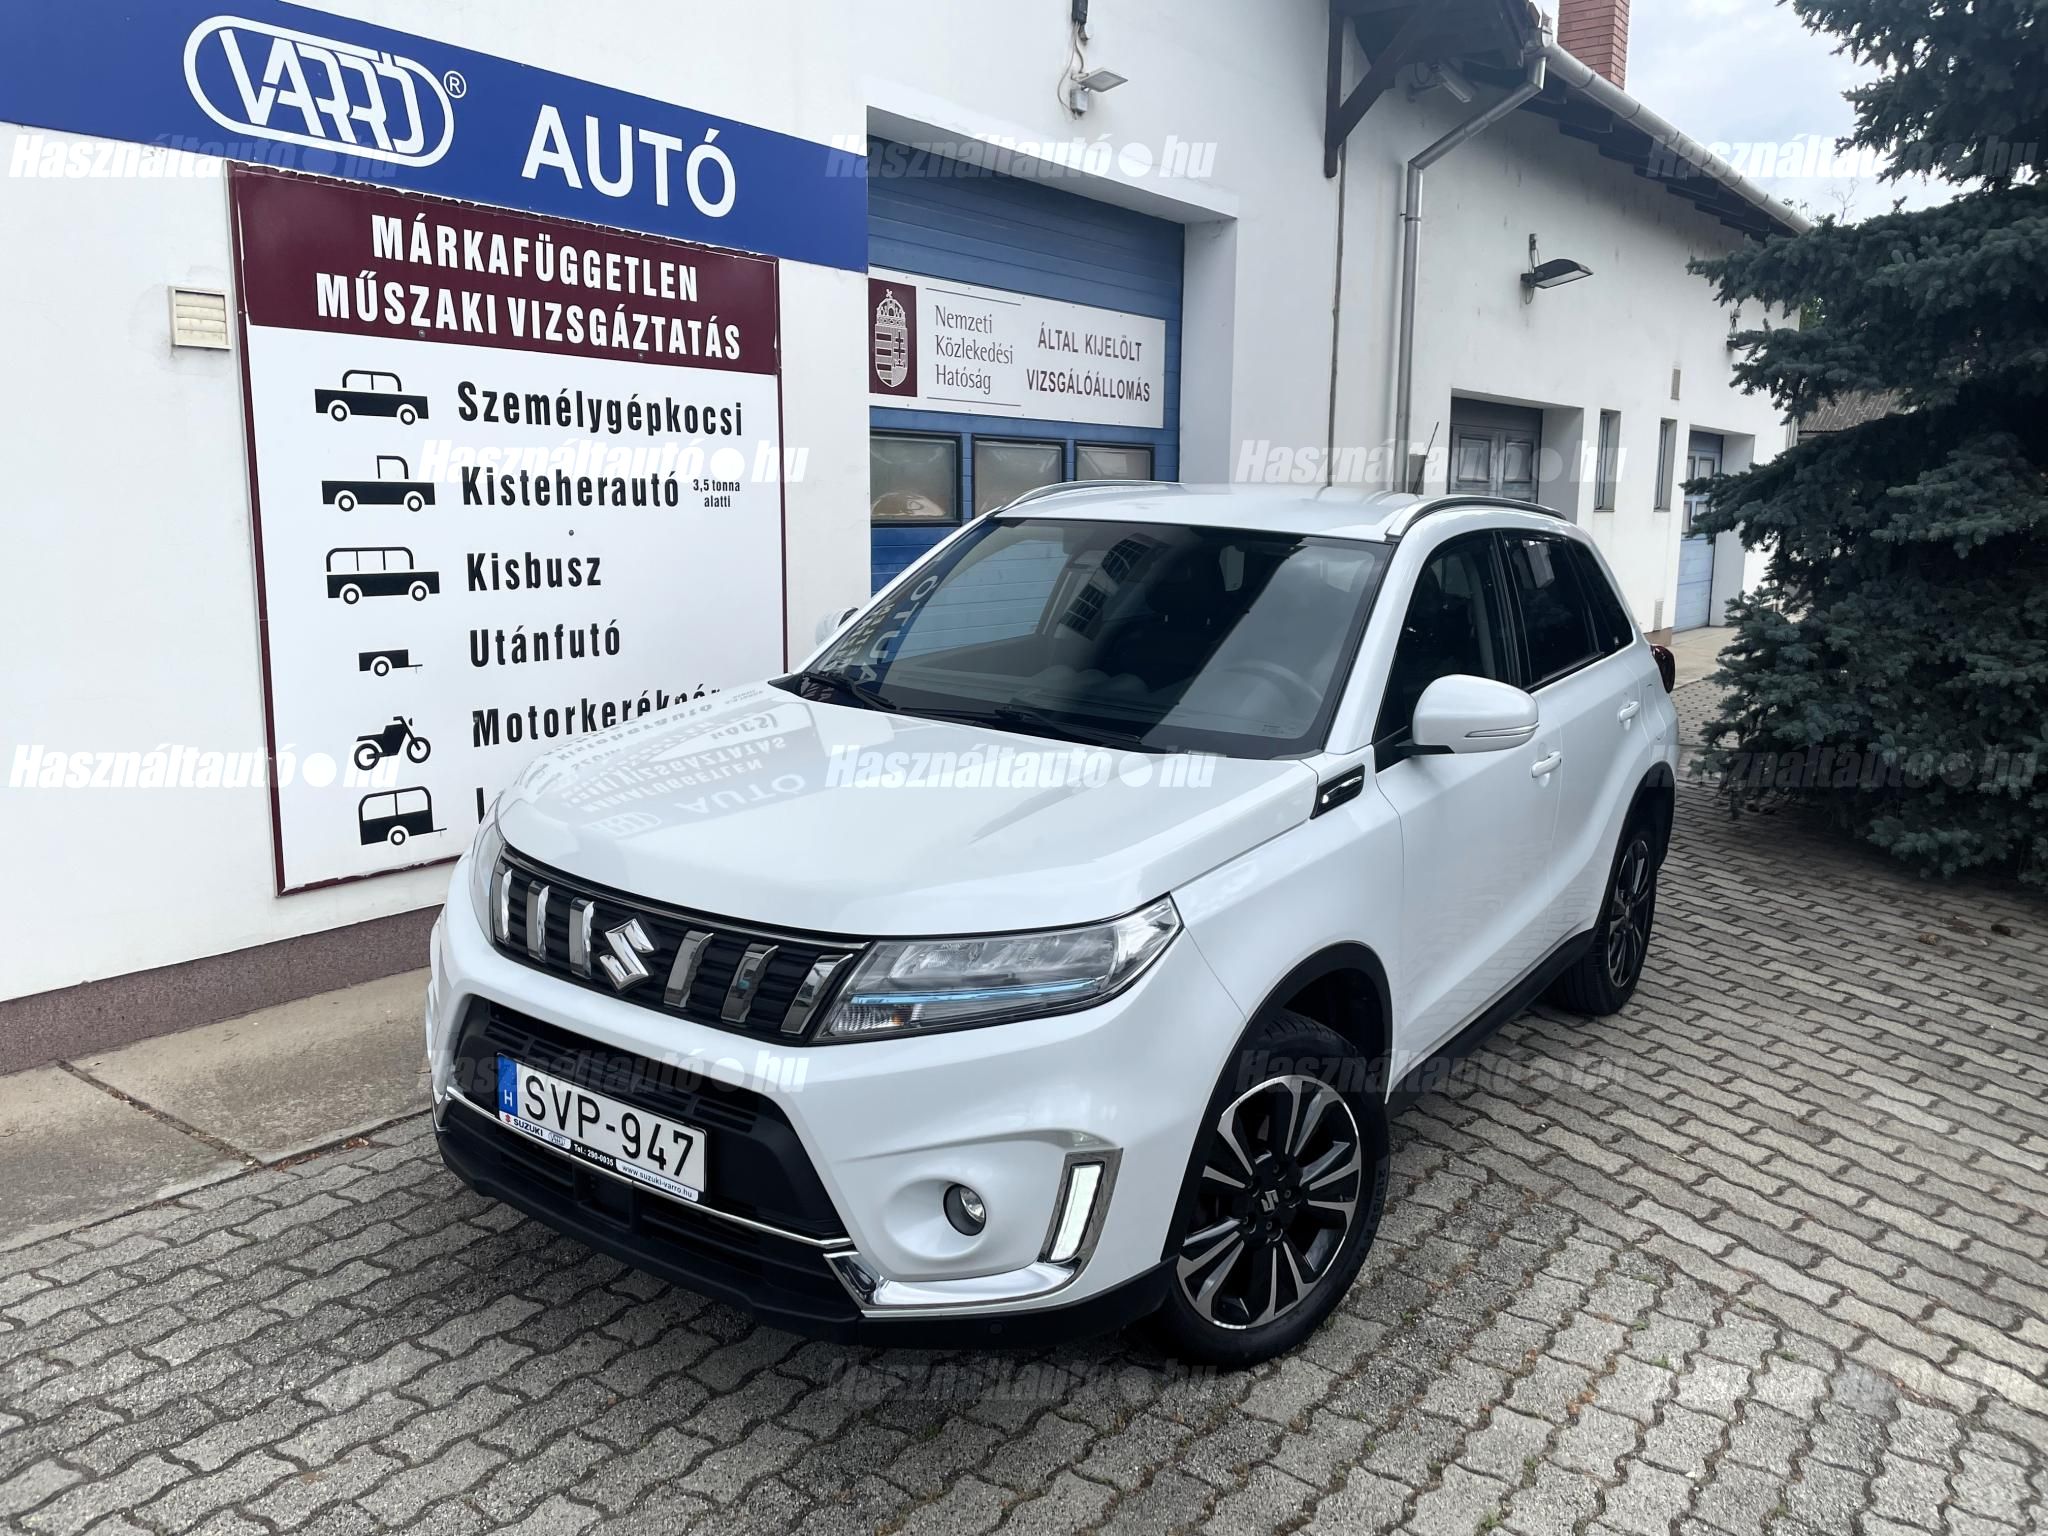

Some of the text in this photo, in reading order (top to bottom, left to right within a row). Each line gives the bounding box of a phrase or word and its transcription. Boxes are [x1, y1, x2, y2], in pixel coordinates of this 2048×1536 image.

[521, 105, 737, 218] AUTÓ
[372, 214, 698, 302] MÁRKAFÜGGETLEN
[316, 270, 742, 360] MŰSZAKI VIZSGÁZTATÁS
[935, 305, 992, 334] Nemzeti
[935, 335, 1013, 364] Közlekedési
[1038, 322, 1142, 361] ÁLTAL KIJELÖLT
[936, 364, 992, 395] Hatóság
[1026, 368, 1150, 402] VIZSGÁLÓÁLLOMÁS
[457, 381, 743, 436] Személygépkocsi
[461, 465, 740, 508] Kisteherautó 3,5 tonna
[704, 494, 731, 508] alatti
[466, 552, 602, 592] Kisbusz
[469, 620, 621, 668] Utánfutó
[472, 683, 720, 747] Motorkerék
[505, 1075, 694, 1177] H SVP-947
[513, 1118, 543, 1137] SUZUKI
[622, 1165, 692, 1198] www.suzuki-varro.hu
